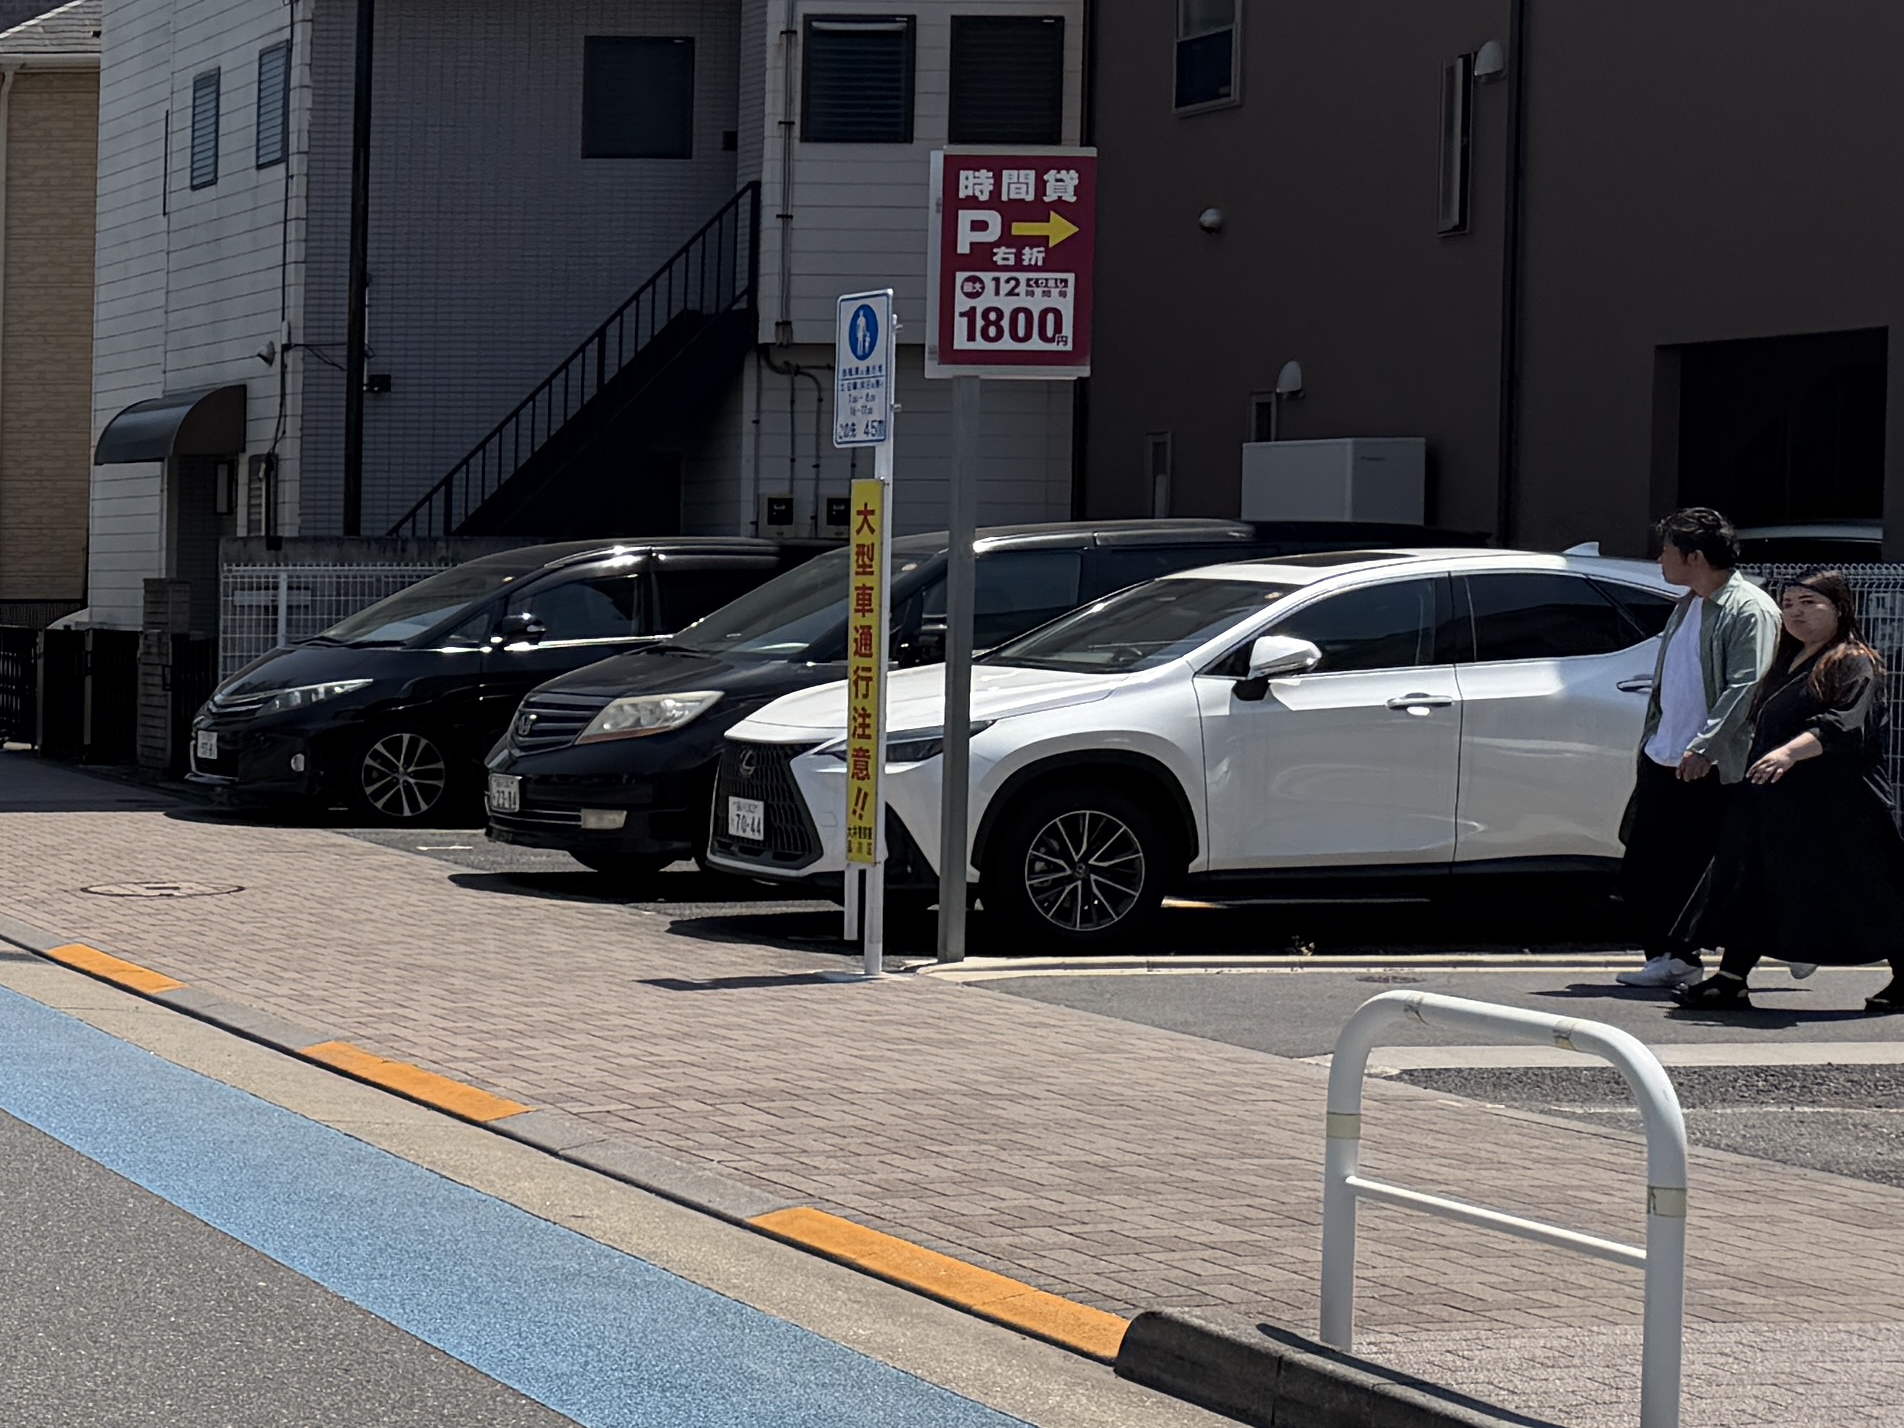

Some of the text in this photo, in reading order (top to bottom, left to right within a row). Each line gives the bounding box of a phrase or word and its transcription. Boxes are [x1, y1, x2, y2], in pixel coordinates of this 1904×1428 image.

[958, 169, 1079, 202] 時間貸
[957, 209, 1002, 254] P
[992, 246, 1045, 266] 右折
[991, 276, 1021, 297] 12
